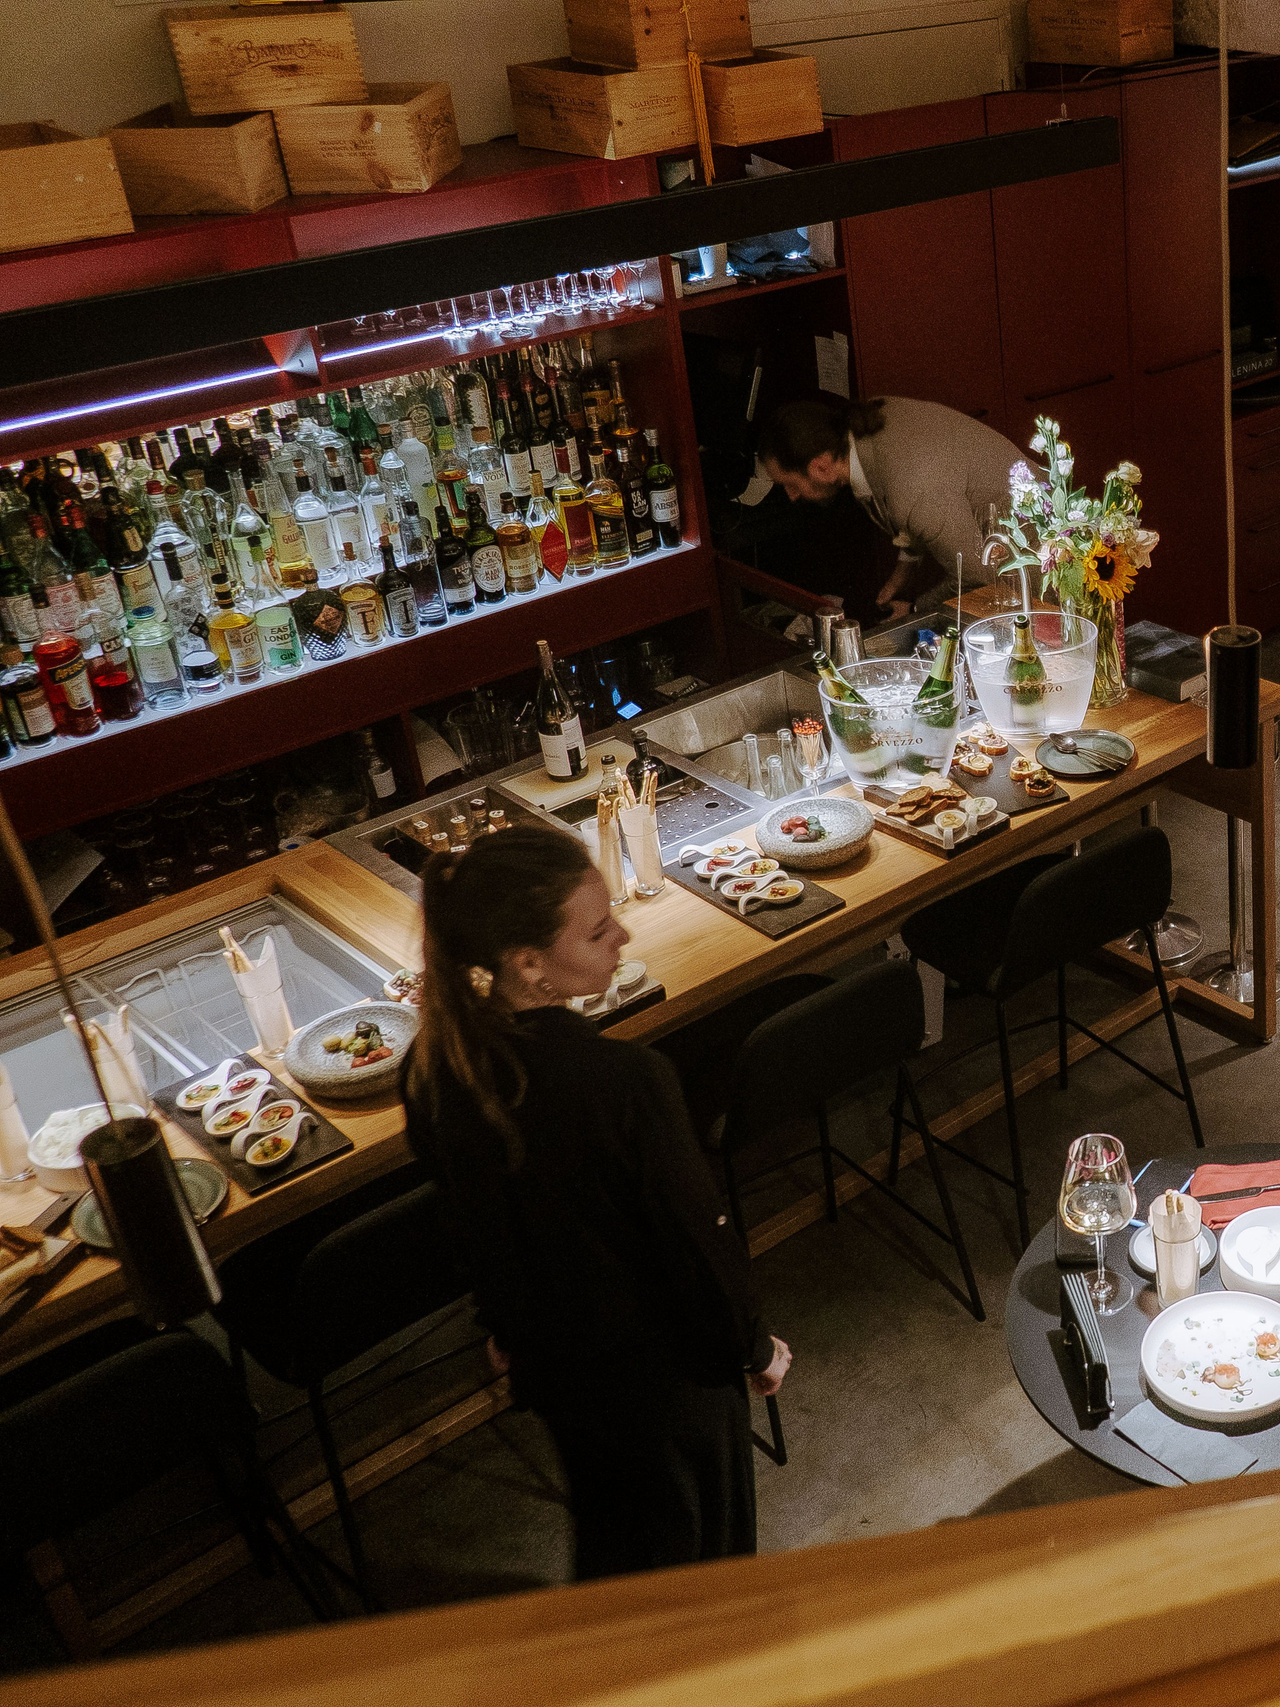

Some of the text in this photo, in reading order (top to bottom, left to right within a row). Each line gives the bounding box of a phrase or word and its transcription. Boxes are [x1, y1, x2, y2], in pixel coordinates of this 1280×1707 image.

[1231, 360, 1263, 378] LENINA
[264, 631, 297, 643] LONDO
[280, 652, 297, 660] GIN
